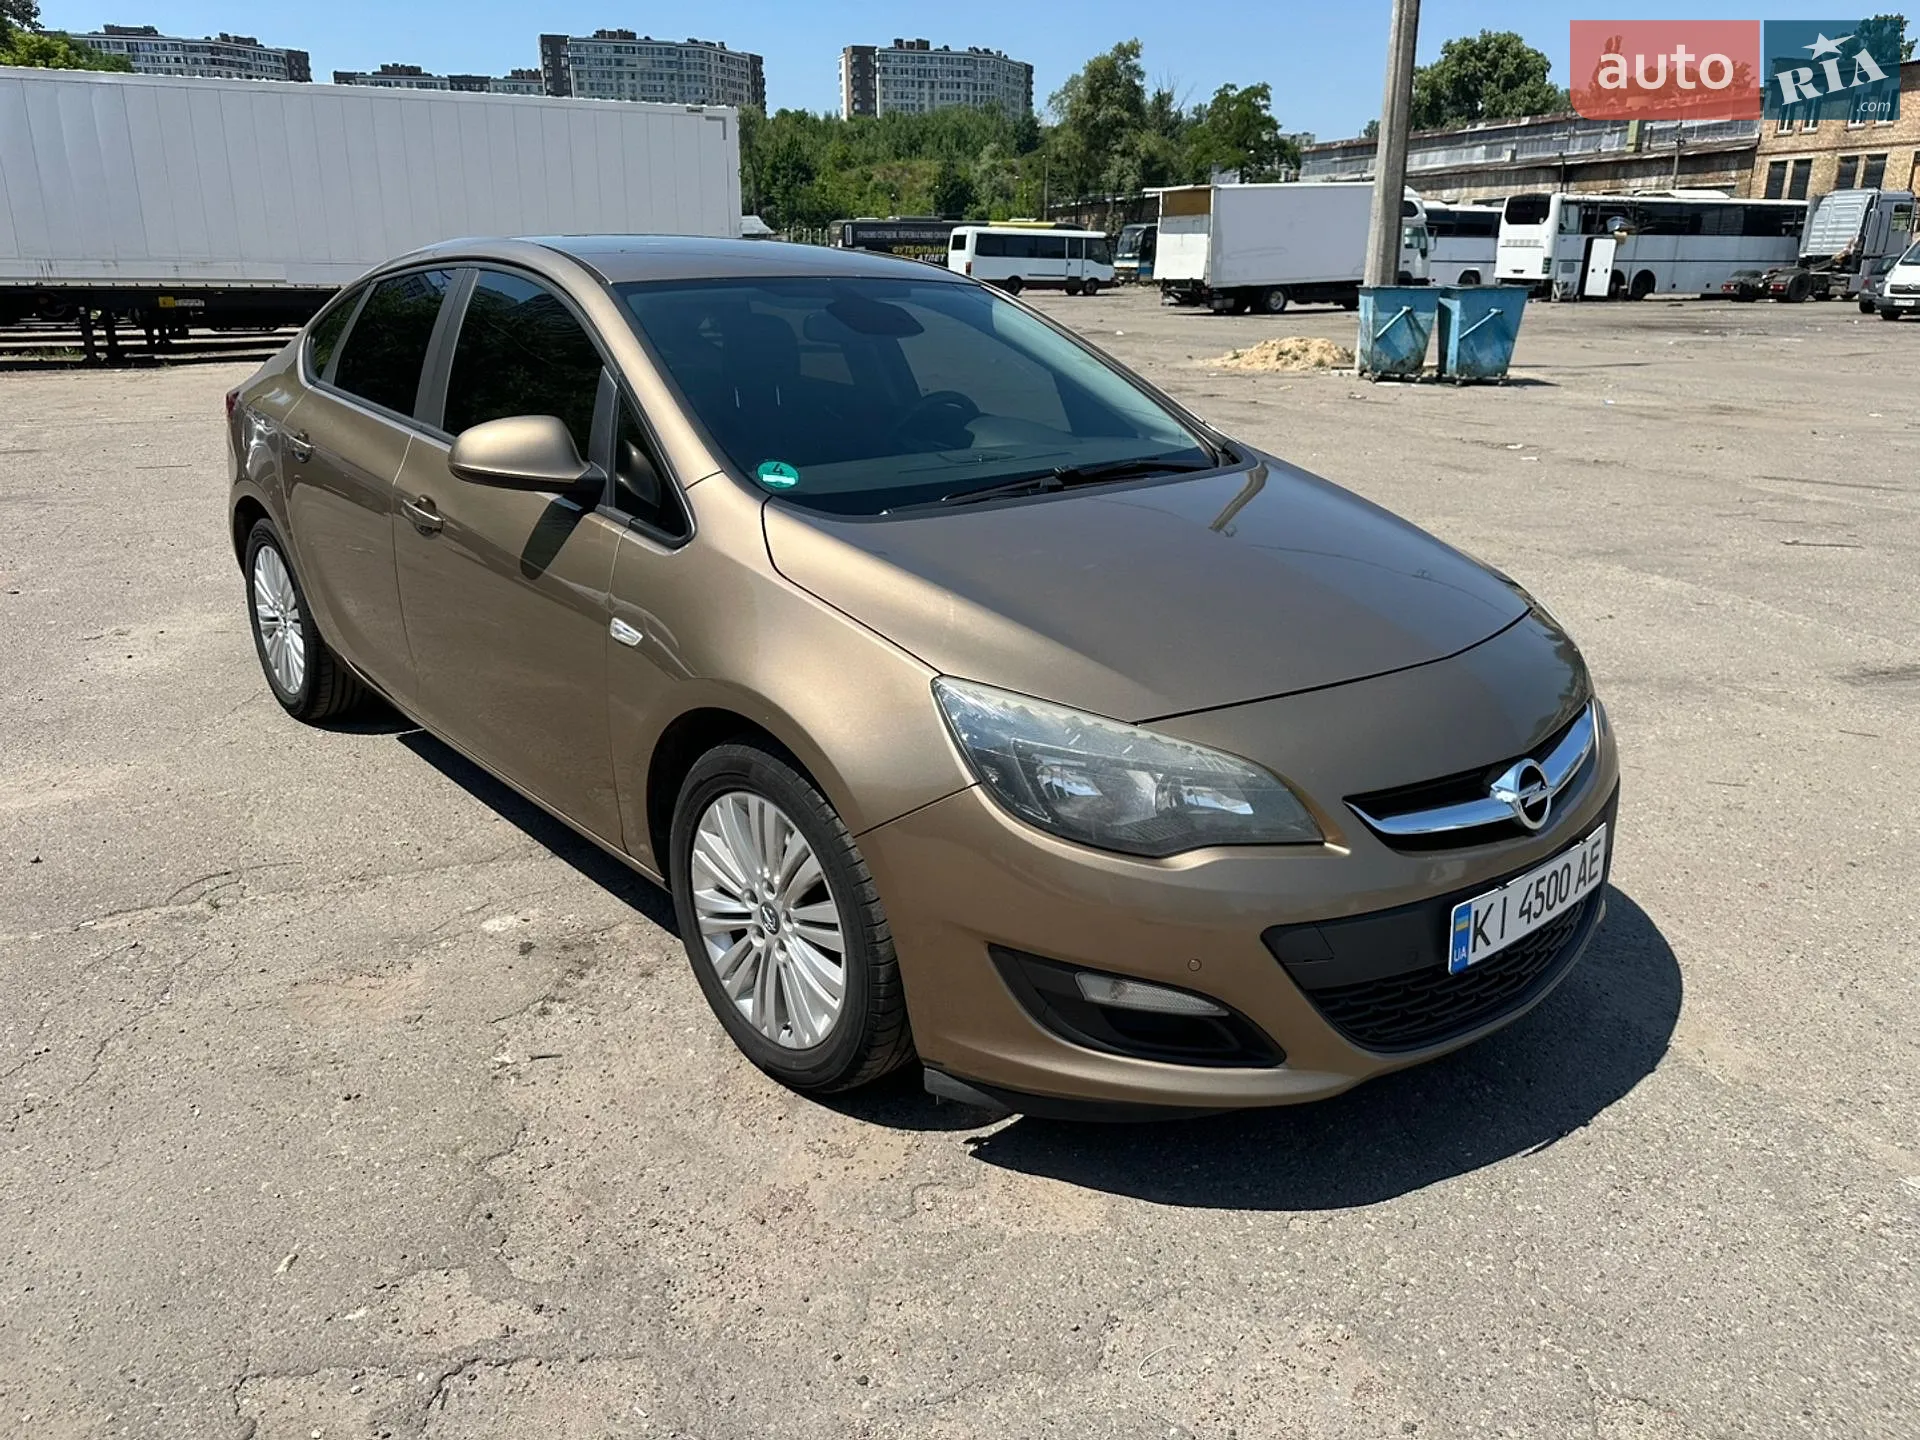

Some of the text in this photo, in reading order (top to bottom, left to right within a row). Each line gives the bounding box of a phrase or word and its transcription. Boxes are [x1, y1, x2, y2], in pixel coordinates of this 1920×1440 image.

[772, 462, 784, 475] 4
[1472, 837, 1601, 953] KI 4500 AE
[1453, 945, 1468, 962] UA
